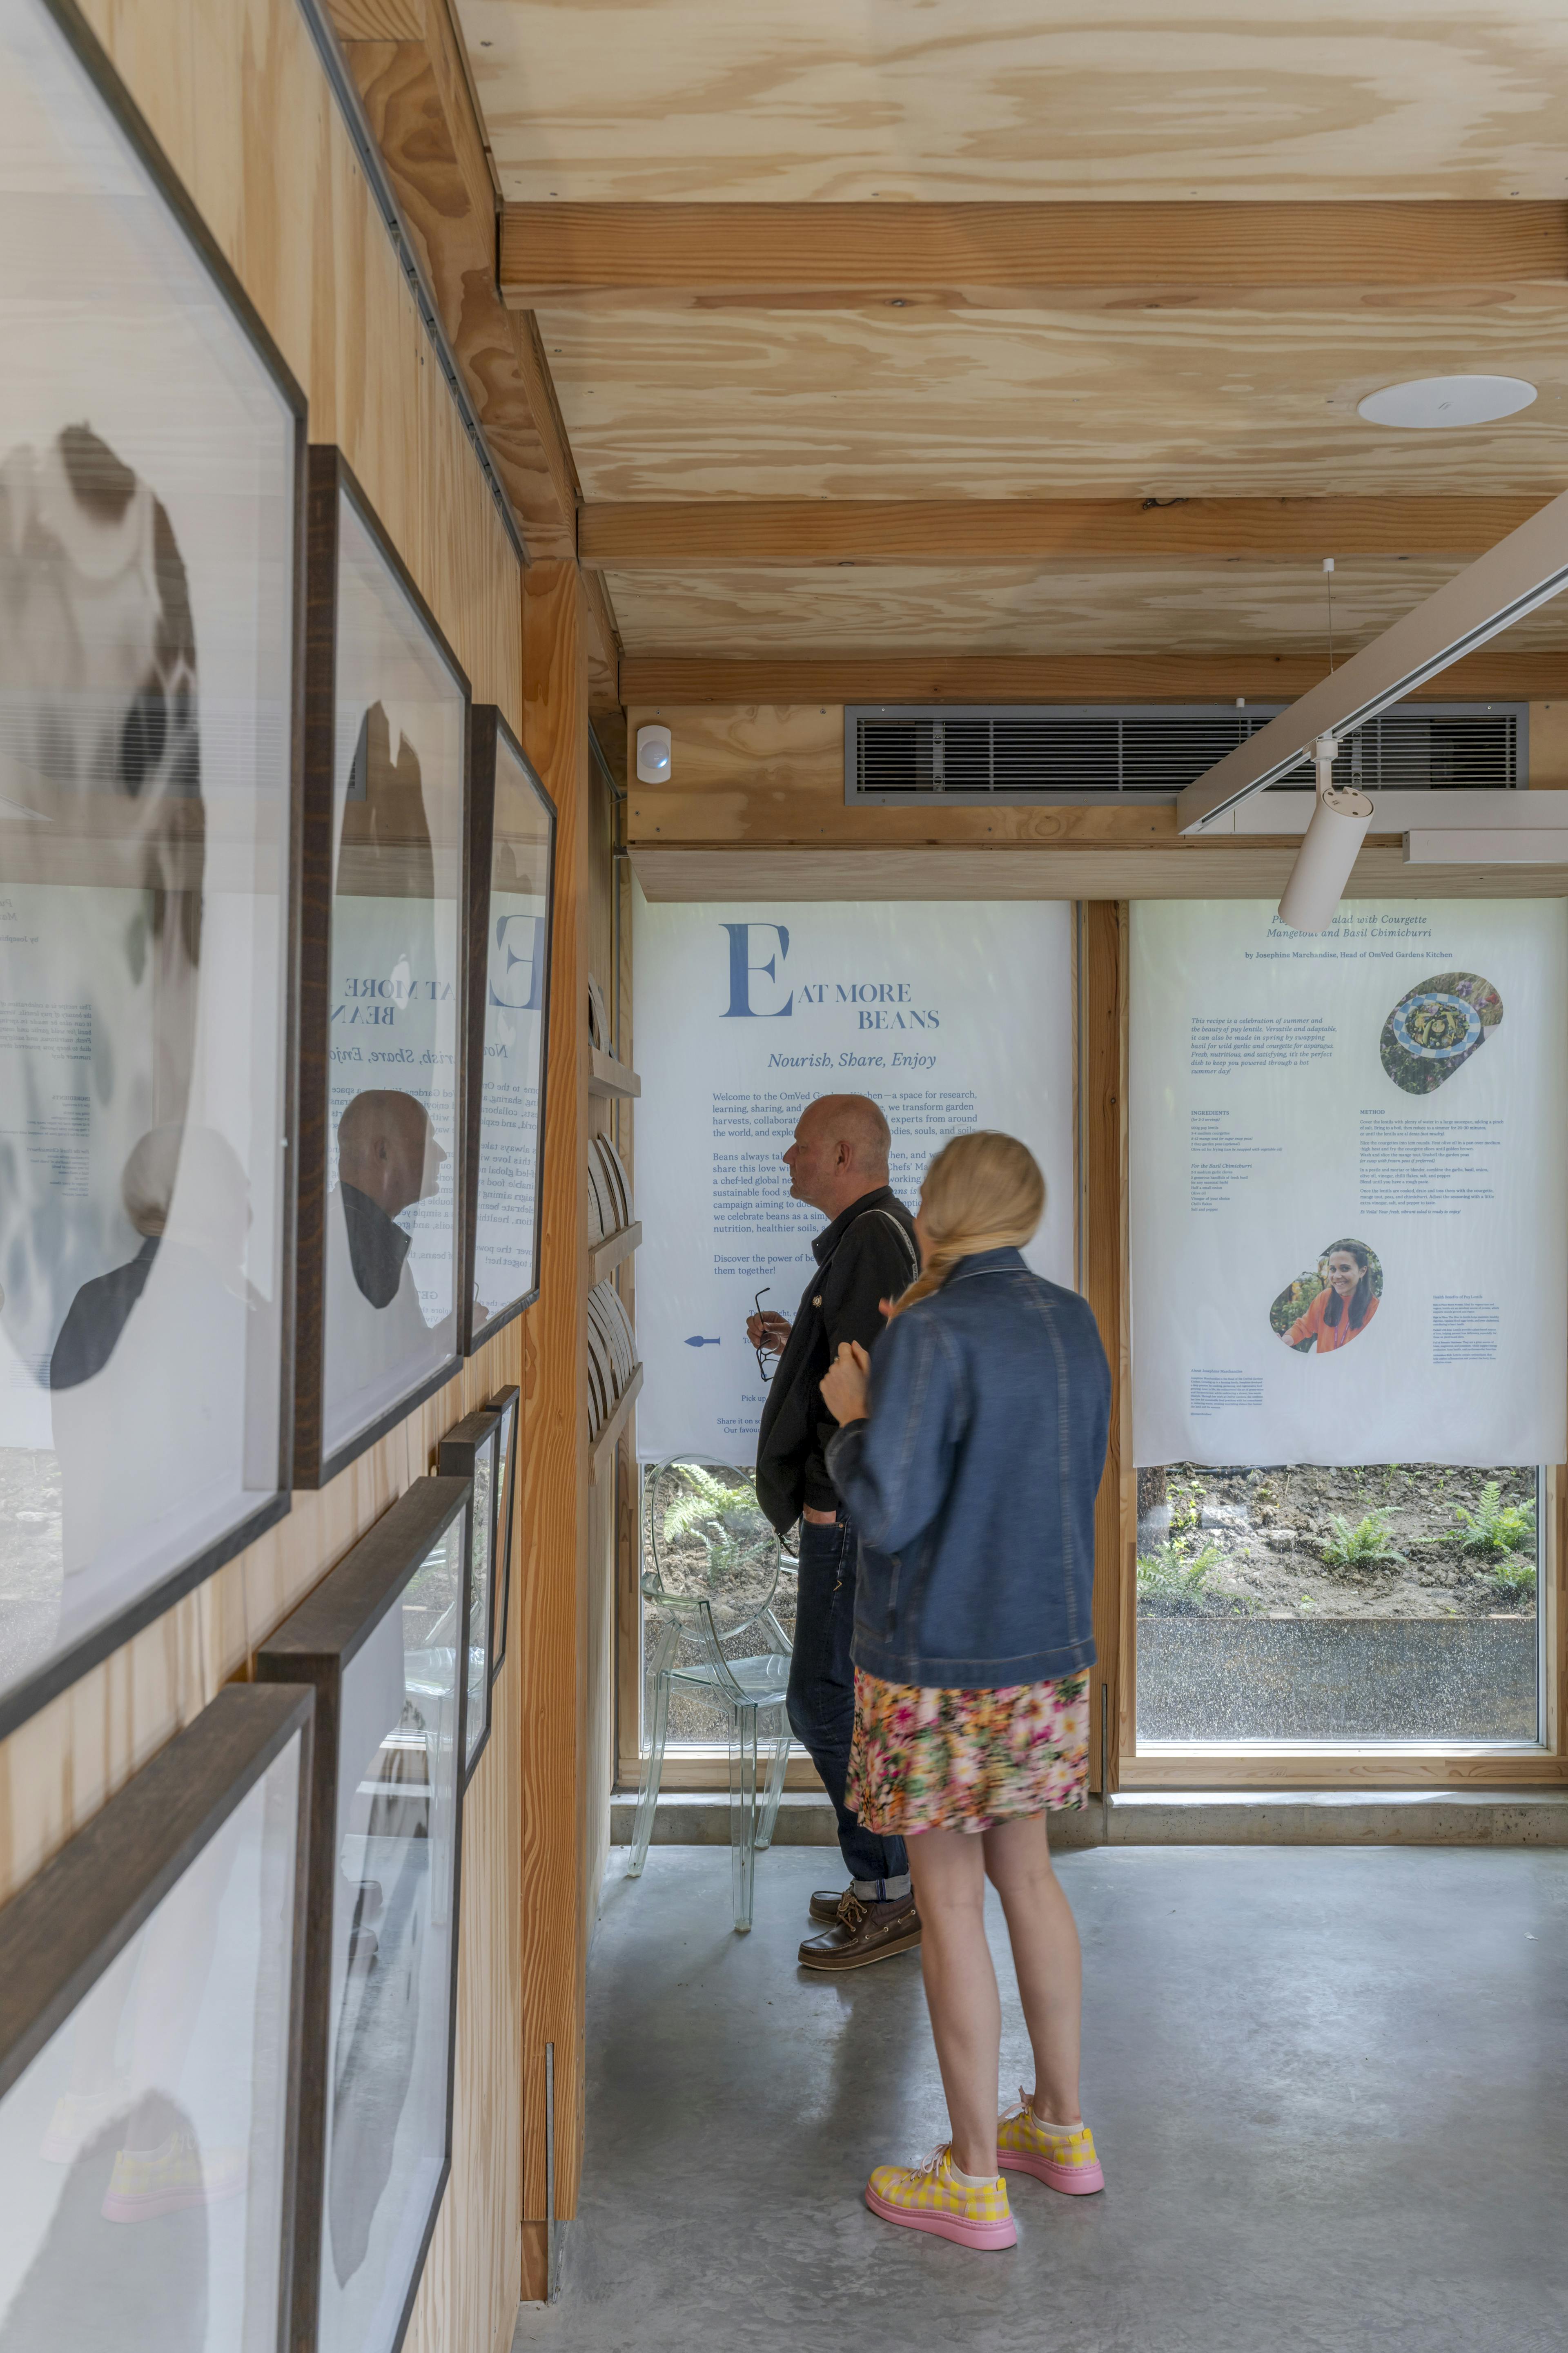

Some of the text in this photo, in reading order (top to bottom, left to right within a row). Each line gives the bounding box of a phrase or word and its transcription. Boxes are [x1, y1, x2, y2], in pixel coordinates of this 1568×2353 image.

[1332, 914, 1354, 924] alad
[1356, 914, 1378, 923] with
[1381, 915, 1427, 926] Courgette
[1321, 928, 1340, 937] and
[1343, 928, 1368, 937] Basil
[1371, 928, 1432, 937] Chimichurri
[835, 984, 911, 1003] MORE
[857, 1010, 940, 1029] BEANS
[768, 1052, 936, 1070] Nourish, Share, Enjoy
[713, 1093, 751, 1101] Welcome
[764, 1092, 777, 1100] the
[780, 1092, 810, 1100] OmVed
[939, 1091, 977, 1099] research,
[713, 1104, 749, 1115] learning,
[751, 1104, 784, 1114] sharing,
[786, 1104, 802, 1112] and
[902, 1102, 943, 1111] transform
[946, 1102, 973, 1112] garden
[713, 1117, 751, 1125] harvests,
[891, 1116, 923, 1124] experts
[926, 1114, 945, 1122] from
[713, 1129, 726, 1137] the
[728, 1128, 753, 1137] world,
[755, 1128, 770, 1136] and
[772, 1128, 795, 1138] explo
[890, 1127, 912, 1135] odies,
[914, 1126, 938, 1135] souls,
[741, 1152, 769, 1162] always
[911, 1151, 926, 1159] and
[739, 1164, 755, 1172] this
[720, 1176, 753, 1184] chef-led
[755, 1176, 779, 1186] global
[889, 1175, 922, 1184] working
[713, 1188, 760, 1196] sustainable
[762, 1188, 780, 1196] food
[713, 1201, 753, 1210] campaign
[755, 1200, 784, 1210] aiming
[728, 1212, 764, 1220] celebrate
[766, 1212, 790, 1220] beans
[714, 1224, 819, 1233] nutrition, healthier soils,
[752, 1254, 765, 1262] the
[738, 1266, 775, 1276] together!
